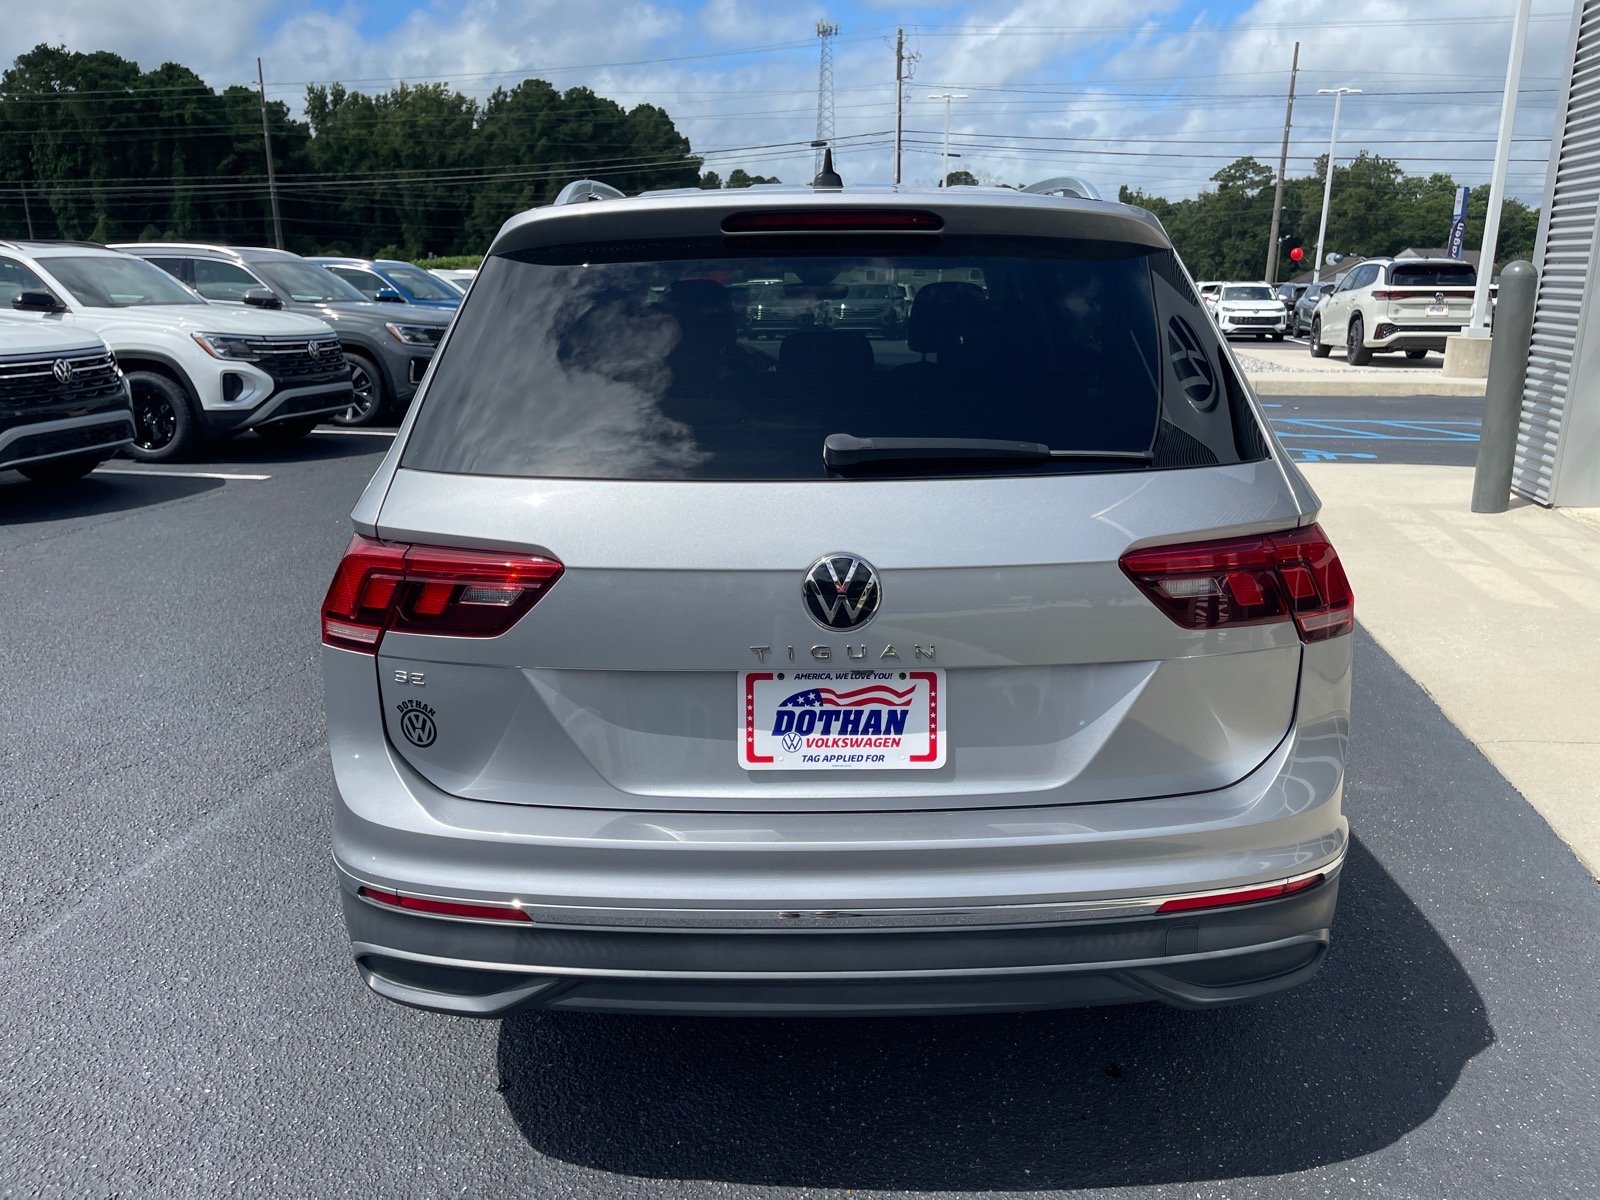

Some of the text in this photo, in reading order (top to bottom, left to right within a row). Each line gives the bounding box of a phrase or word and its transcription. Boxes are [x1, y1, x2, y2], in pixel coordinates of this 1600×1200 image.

[750, 644, 936, 660] TIGUAN
[794, 672, 894, 681] AMERICA, WE LOVE YOU!
[396, 700, 436, 717] DOTHAN
[771, 709, 910, 737] DOTHAN
[806, 737, 902, 748] VOLKSWAGEN
[802, 754, 886, 763] TAG APPLIED FOR
